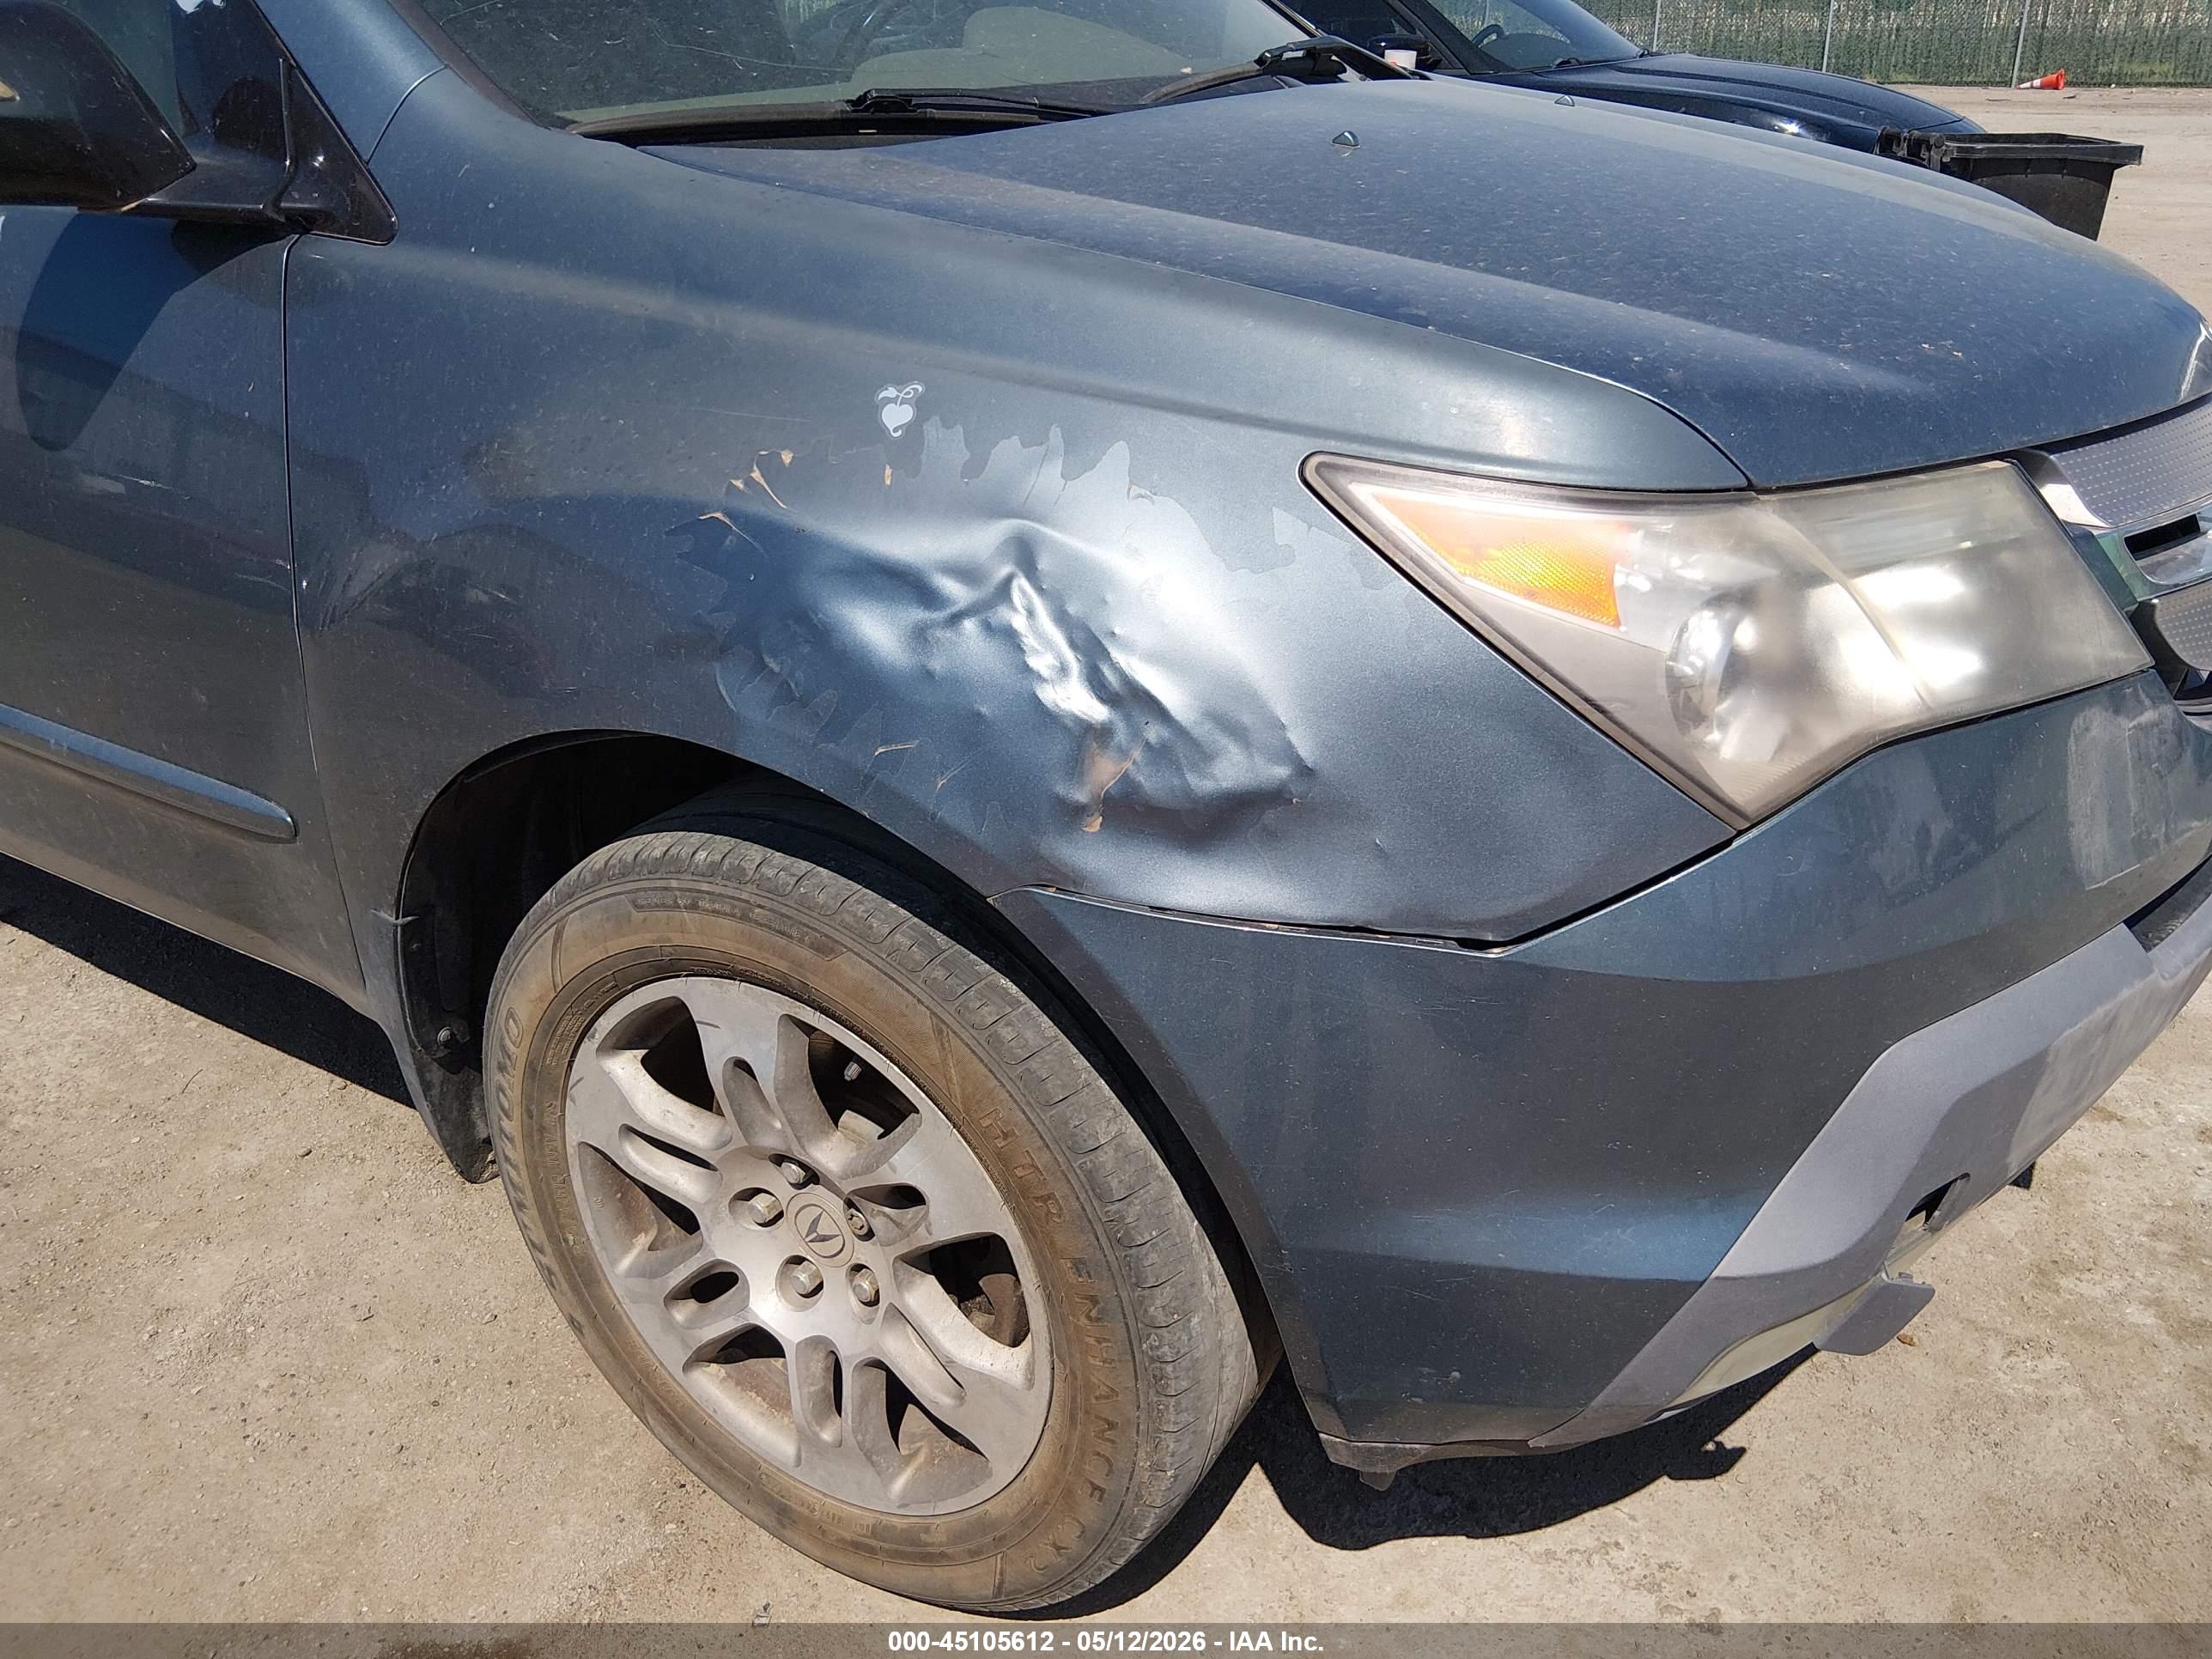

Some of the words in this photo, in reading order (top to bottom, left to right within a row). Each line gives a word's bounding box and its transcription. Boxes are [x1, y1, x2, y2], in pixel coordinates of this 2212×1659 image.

[495, 1004, 560, 1291] SUMITOMO
[978, 1107, 1067, 1227] HTR
[1060, 1256, 1120, 1505] ENHANCE
[1022, 1512, 1087, 1575] CX2
